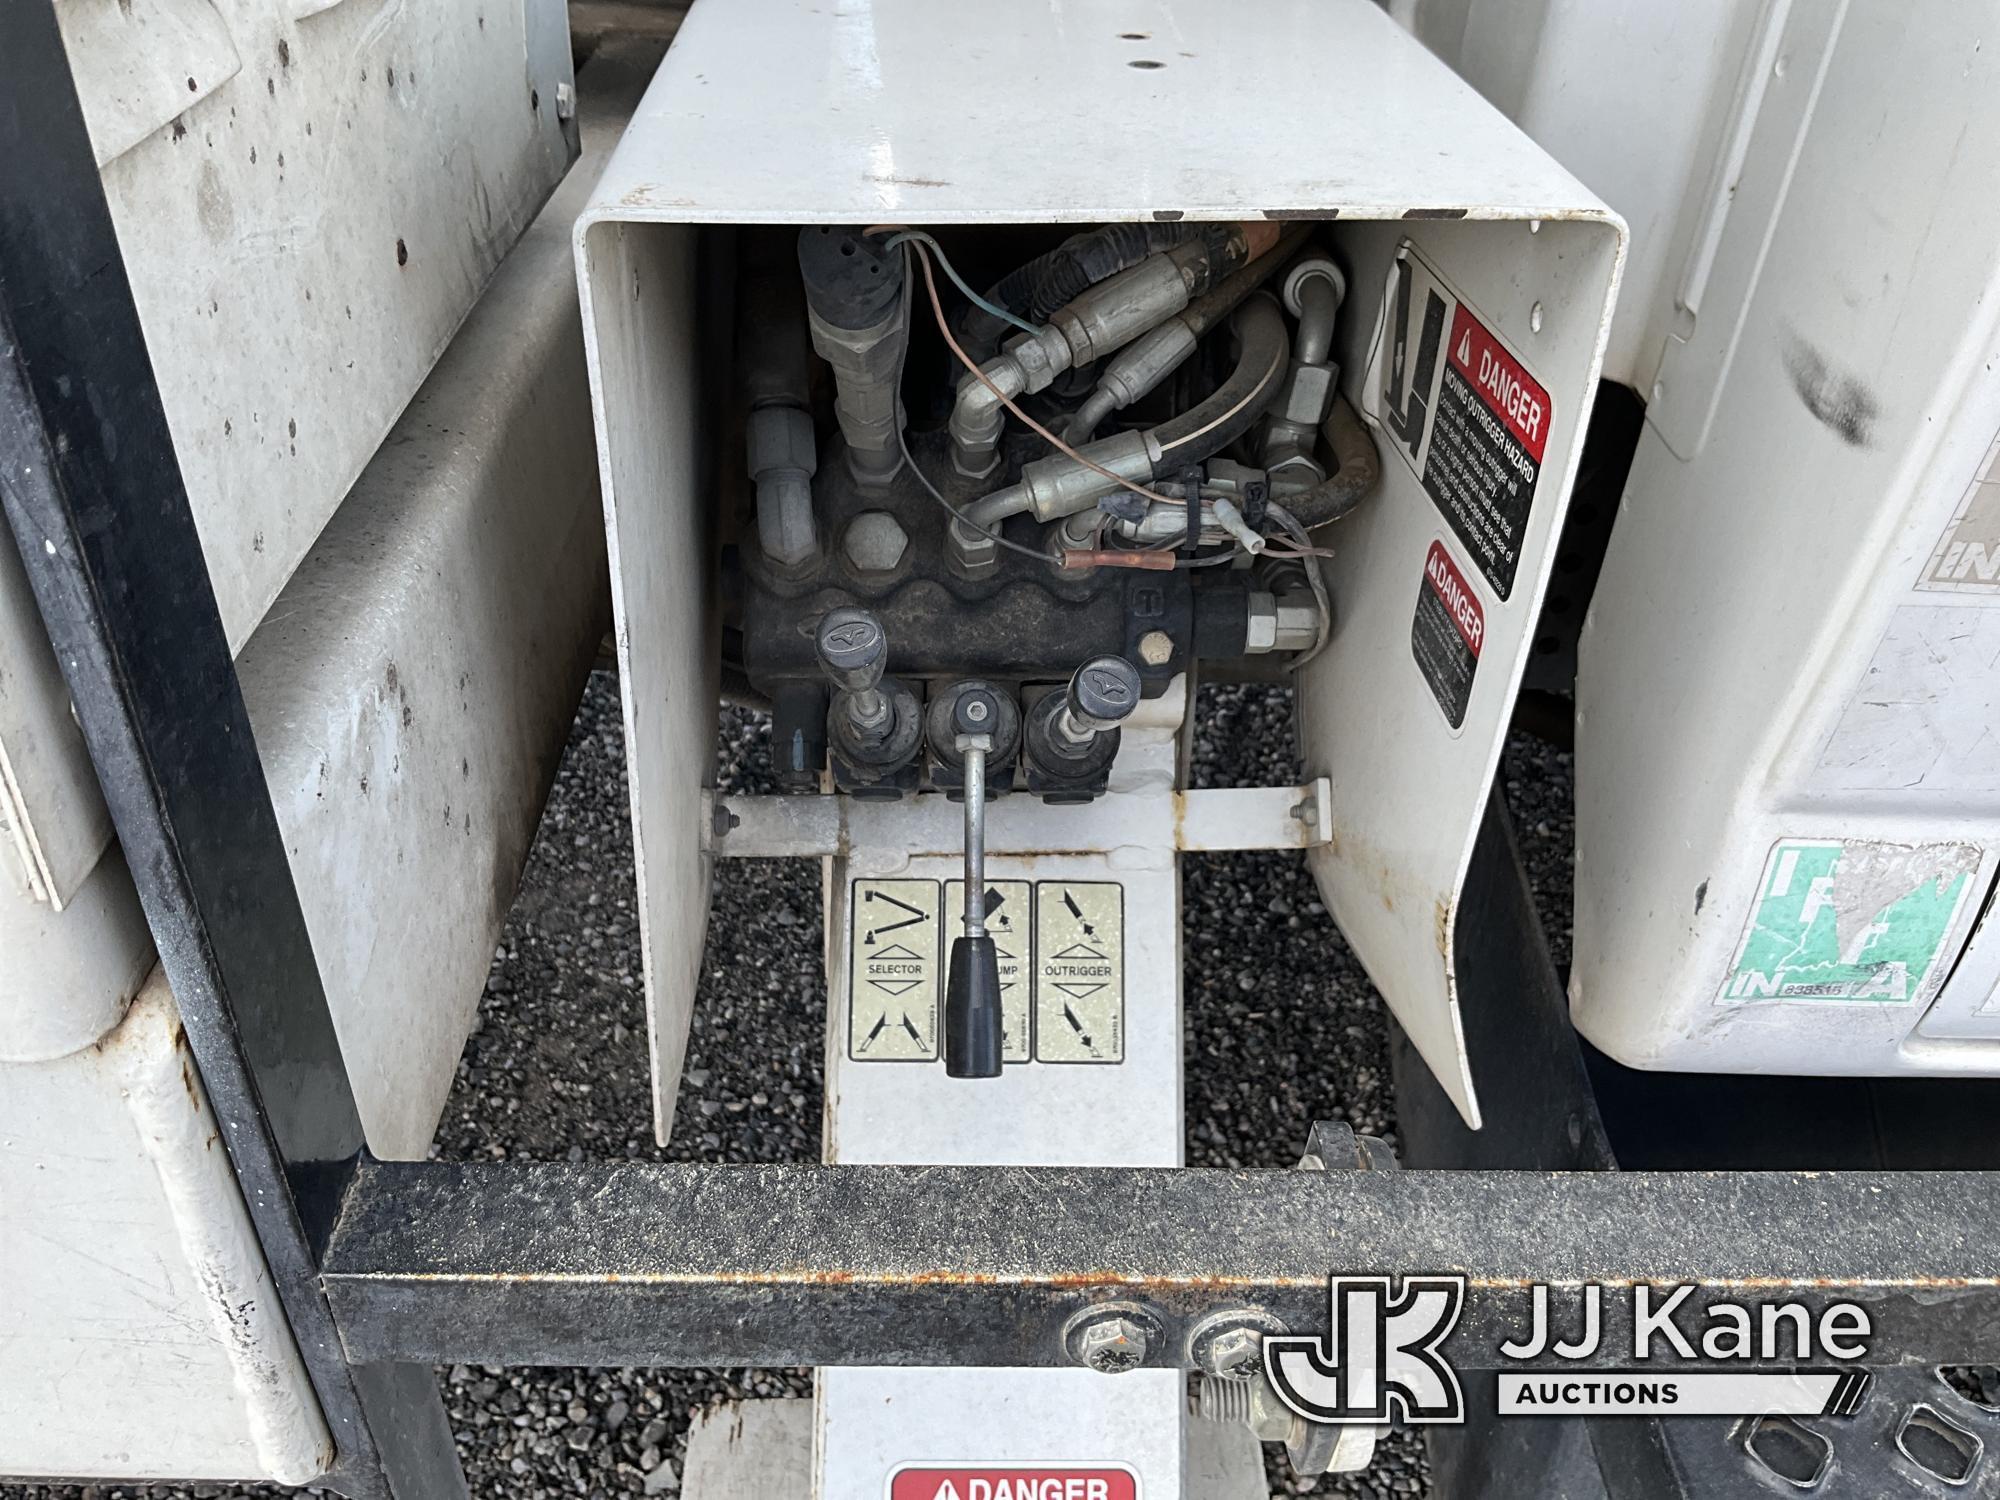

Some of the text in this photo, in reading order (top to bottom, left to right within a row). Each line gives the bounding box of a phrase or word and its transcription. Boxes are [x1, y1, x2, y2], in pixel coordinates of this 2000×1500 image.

[1445, 367, 1533, 483] MOVING OUTRIGGER HAZARD
[1478, 349, 1540, 441] DANGER
[1436, 411, 1448, 432] cause
[1460, 444, 1466, 453] or
[1466, 450, 1483, 477] serious
[1439, 391, 1456, 419] Contact
[1464, 426, 1468, 436] a
[1469, 431, 1486, 460] moving
[1485, 452, 1508, 484] outrigger
[1507, 479, 1517, 496] will
[1432, 471, 1451, 500] outrigger
[1450, 497, 1460, 513] and
[1464, 518, 1482, 546] contact
[1441, 439, 1446, 449] or
[1446, 446, 1450, 456] a
[1462, 468, 1479, 495] person
[1478, 490, 1491, 511] must
[1490, 506, 1500, 523] see
[1500, 517, 1511, 538] that
[1448, 472, 1458, 489] and
[1457, 484, 1484, 526] obstructions
[1484, 521, 1493, 537] are
[1492, 533, 1506, 554] clear
[1505, 550, 1513, 563] of
[1437, 561, 1482, 648] DANGER
[869, 965, 922, 975] SELECTOR
[998, 965, 1018, 975] UMP
[1045, 966, 1112, 976] OUTRIGGER
[1729, 972, 1785, 997] IN
[969, 1479, 1109, 1500] DANGER
